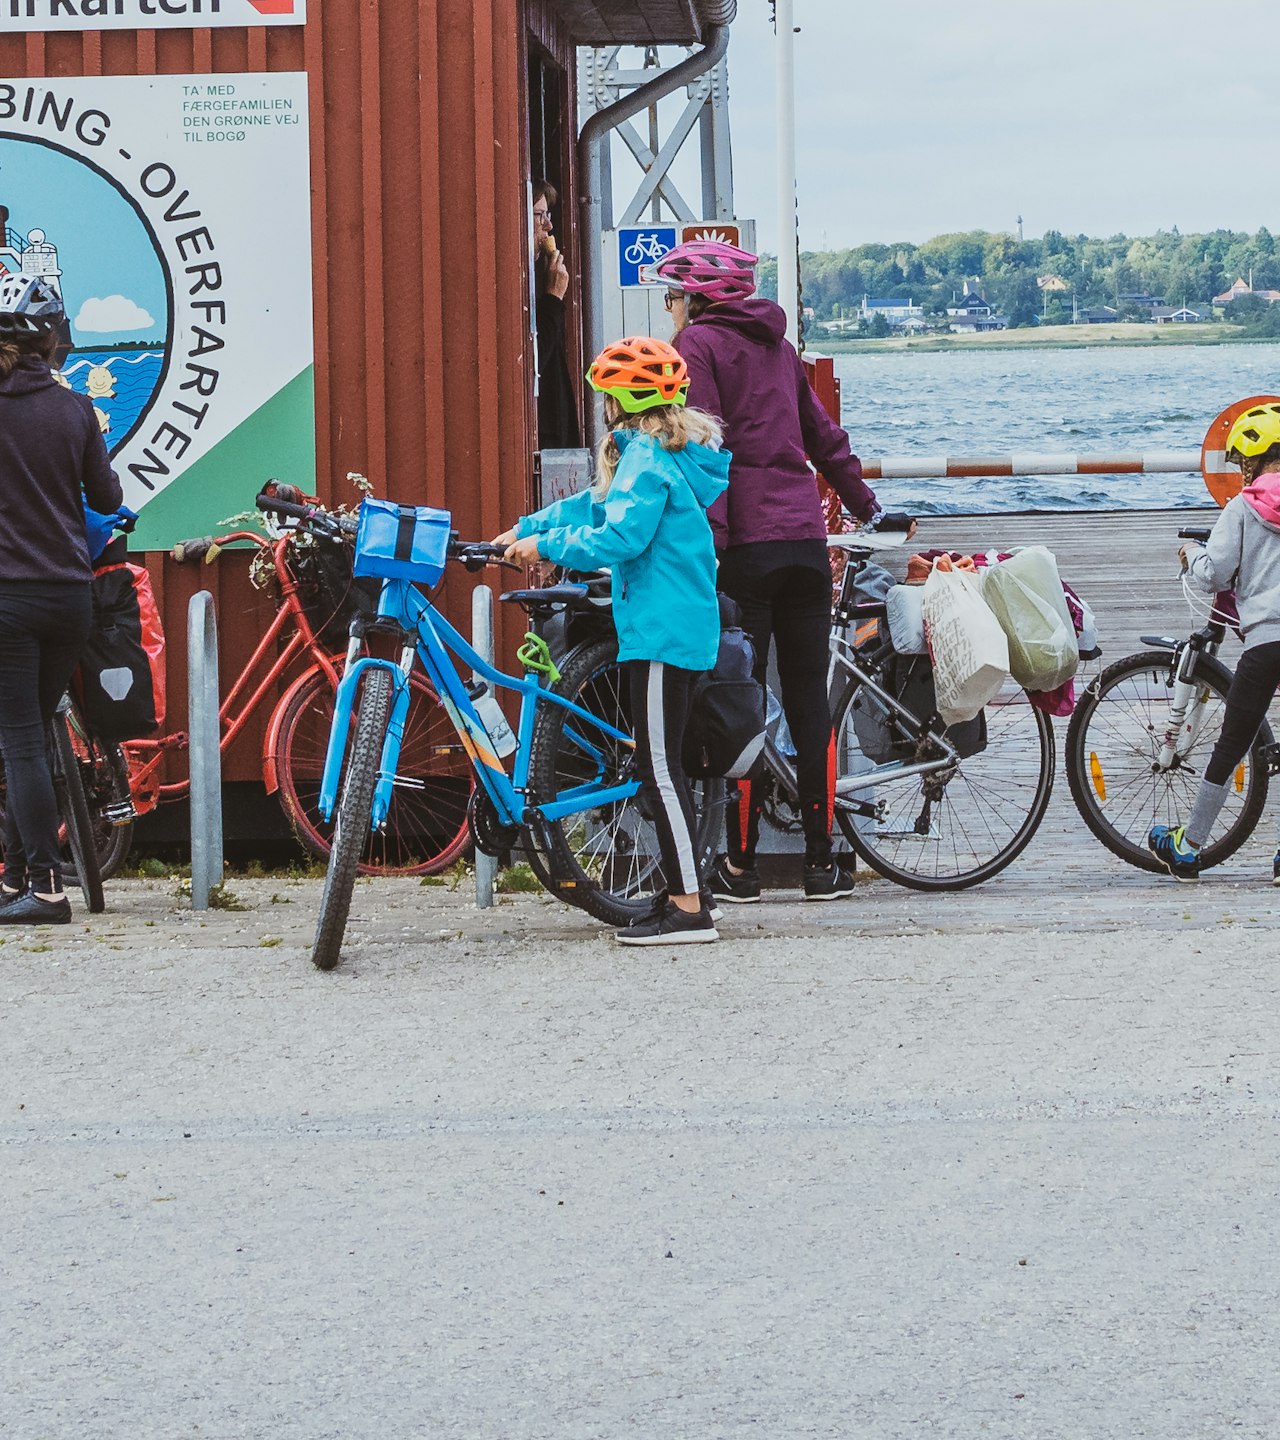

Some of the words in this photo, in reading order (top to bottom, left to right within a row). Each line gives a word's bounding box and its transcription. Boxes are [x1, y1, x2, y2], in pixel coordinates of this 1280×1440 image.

[182, 85, 204, 96] TA'
[207, 84, 235, 96] MED
[182, 98, 293, 112] FÆRGEFAMILIEN
[183, 116, 210, 127] DEN
[214, 115, 271, 127] GRØNNE
[275, 114, 299, 126] VEJ
[183, 131, 203, 143] TIL
[207, 130, 246, 142] BOGØ
[127, 161, 226, 491] OVERFARTEN
